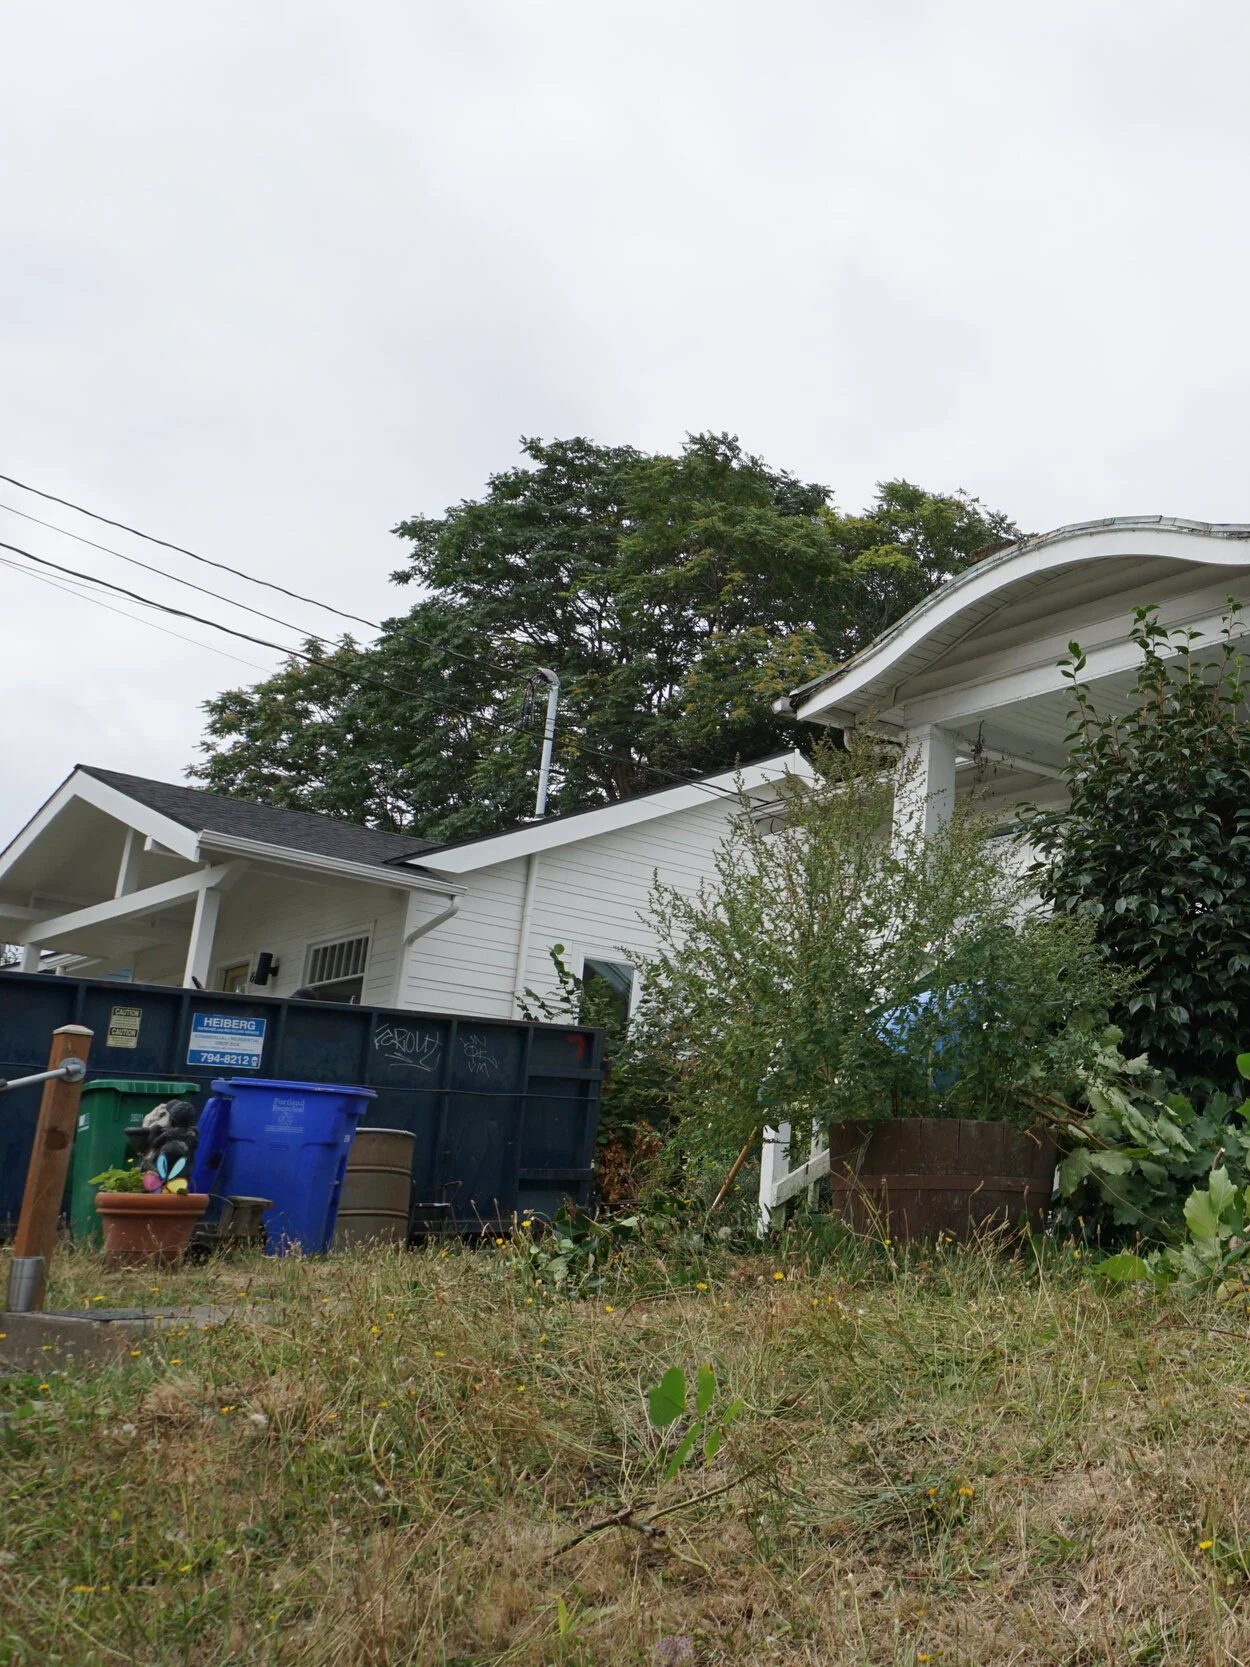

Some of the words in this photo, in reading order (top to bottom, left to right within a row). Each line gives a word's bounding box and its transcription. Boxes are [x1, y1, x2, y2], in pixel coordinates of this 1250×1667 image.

[115, 1008, 139, 1017] CAUTION
[204, 1017, 256, 1030] HEIBERG
[111, 1028, 136, 1037] CAUTION
[200, 1053, 250, 1065] 794-8212
